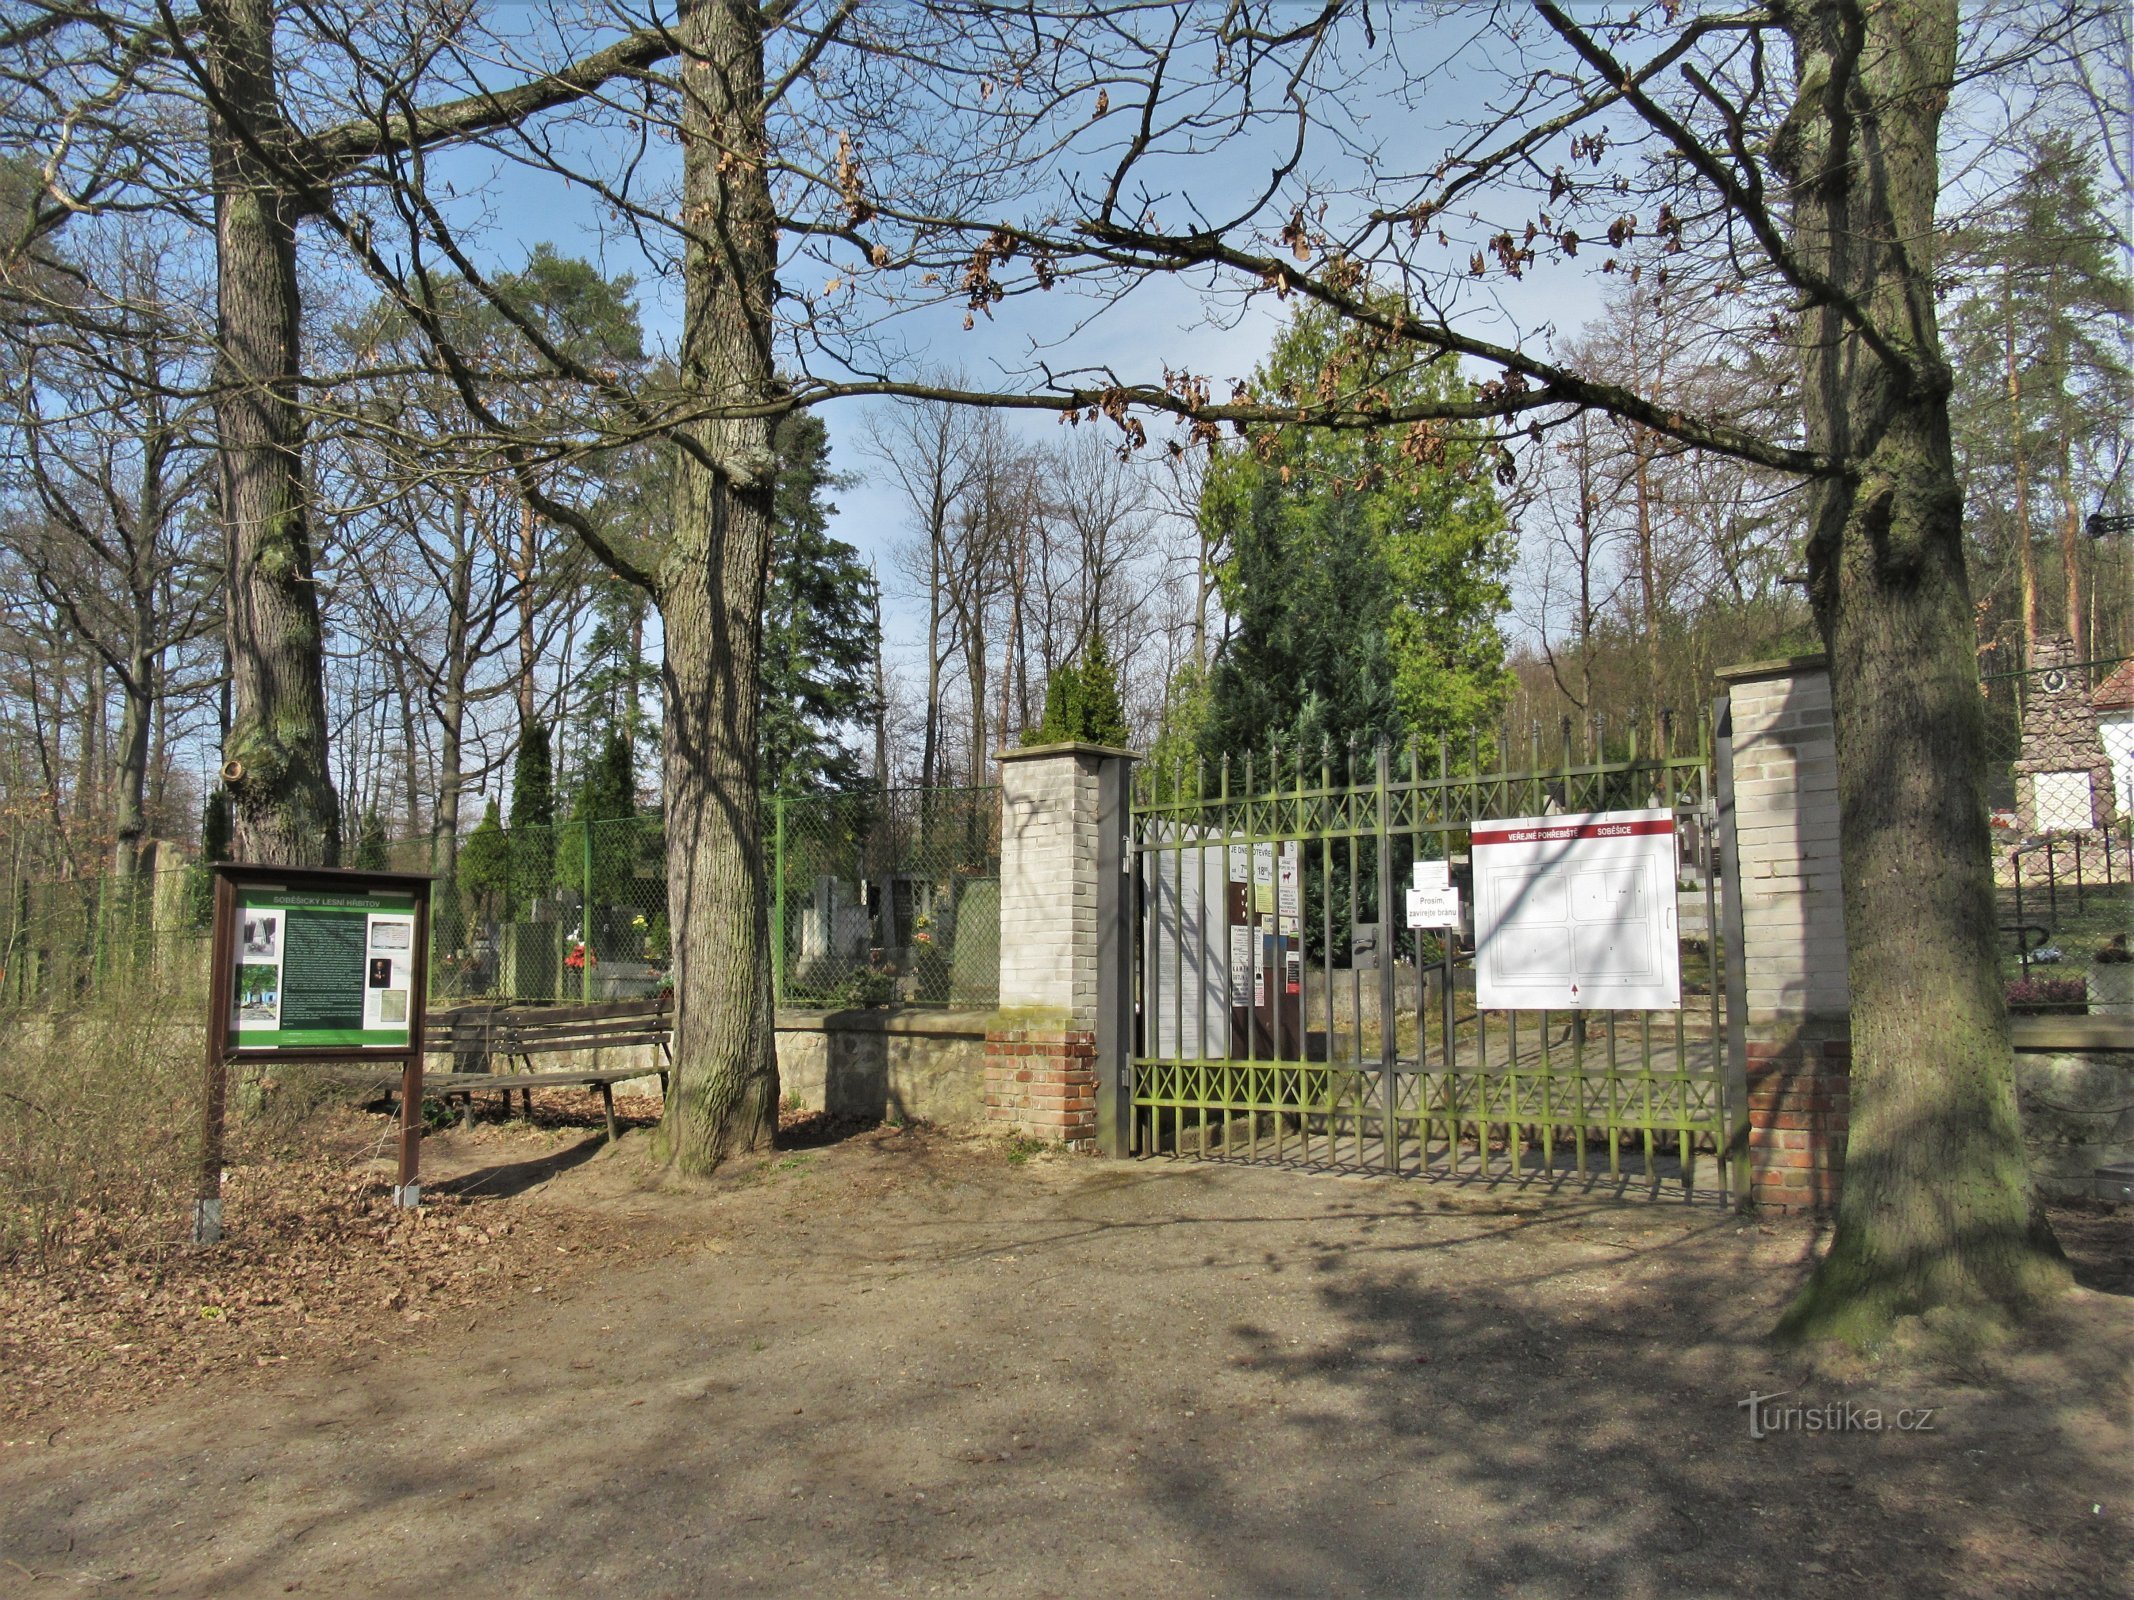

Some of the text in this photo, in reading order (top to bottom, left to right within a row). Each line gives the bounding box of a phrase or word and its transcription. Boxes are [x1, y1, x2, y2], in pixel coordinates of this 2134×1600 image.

[1508, 831, 1537, 841] VEŘEJNÉ
[1597, 826, 1632, 836] SOBĚŠICE
[273, 896, 381, 908] SOBĚŠICKÝ LESNÍ HŘBITOV
[1419, 897, 1445, 905] Prosím,
[1437, 908, 1457, 916] bránu
